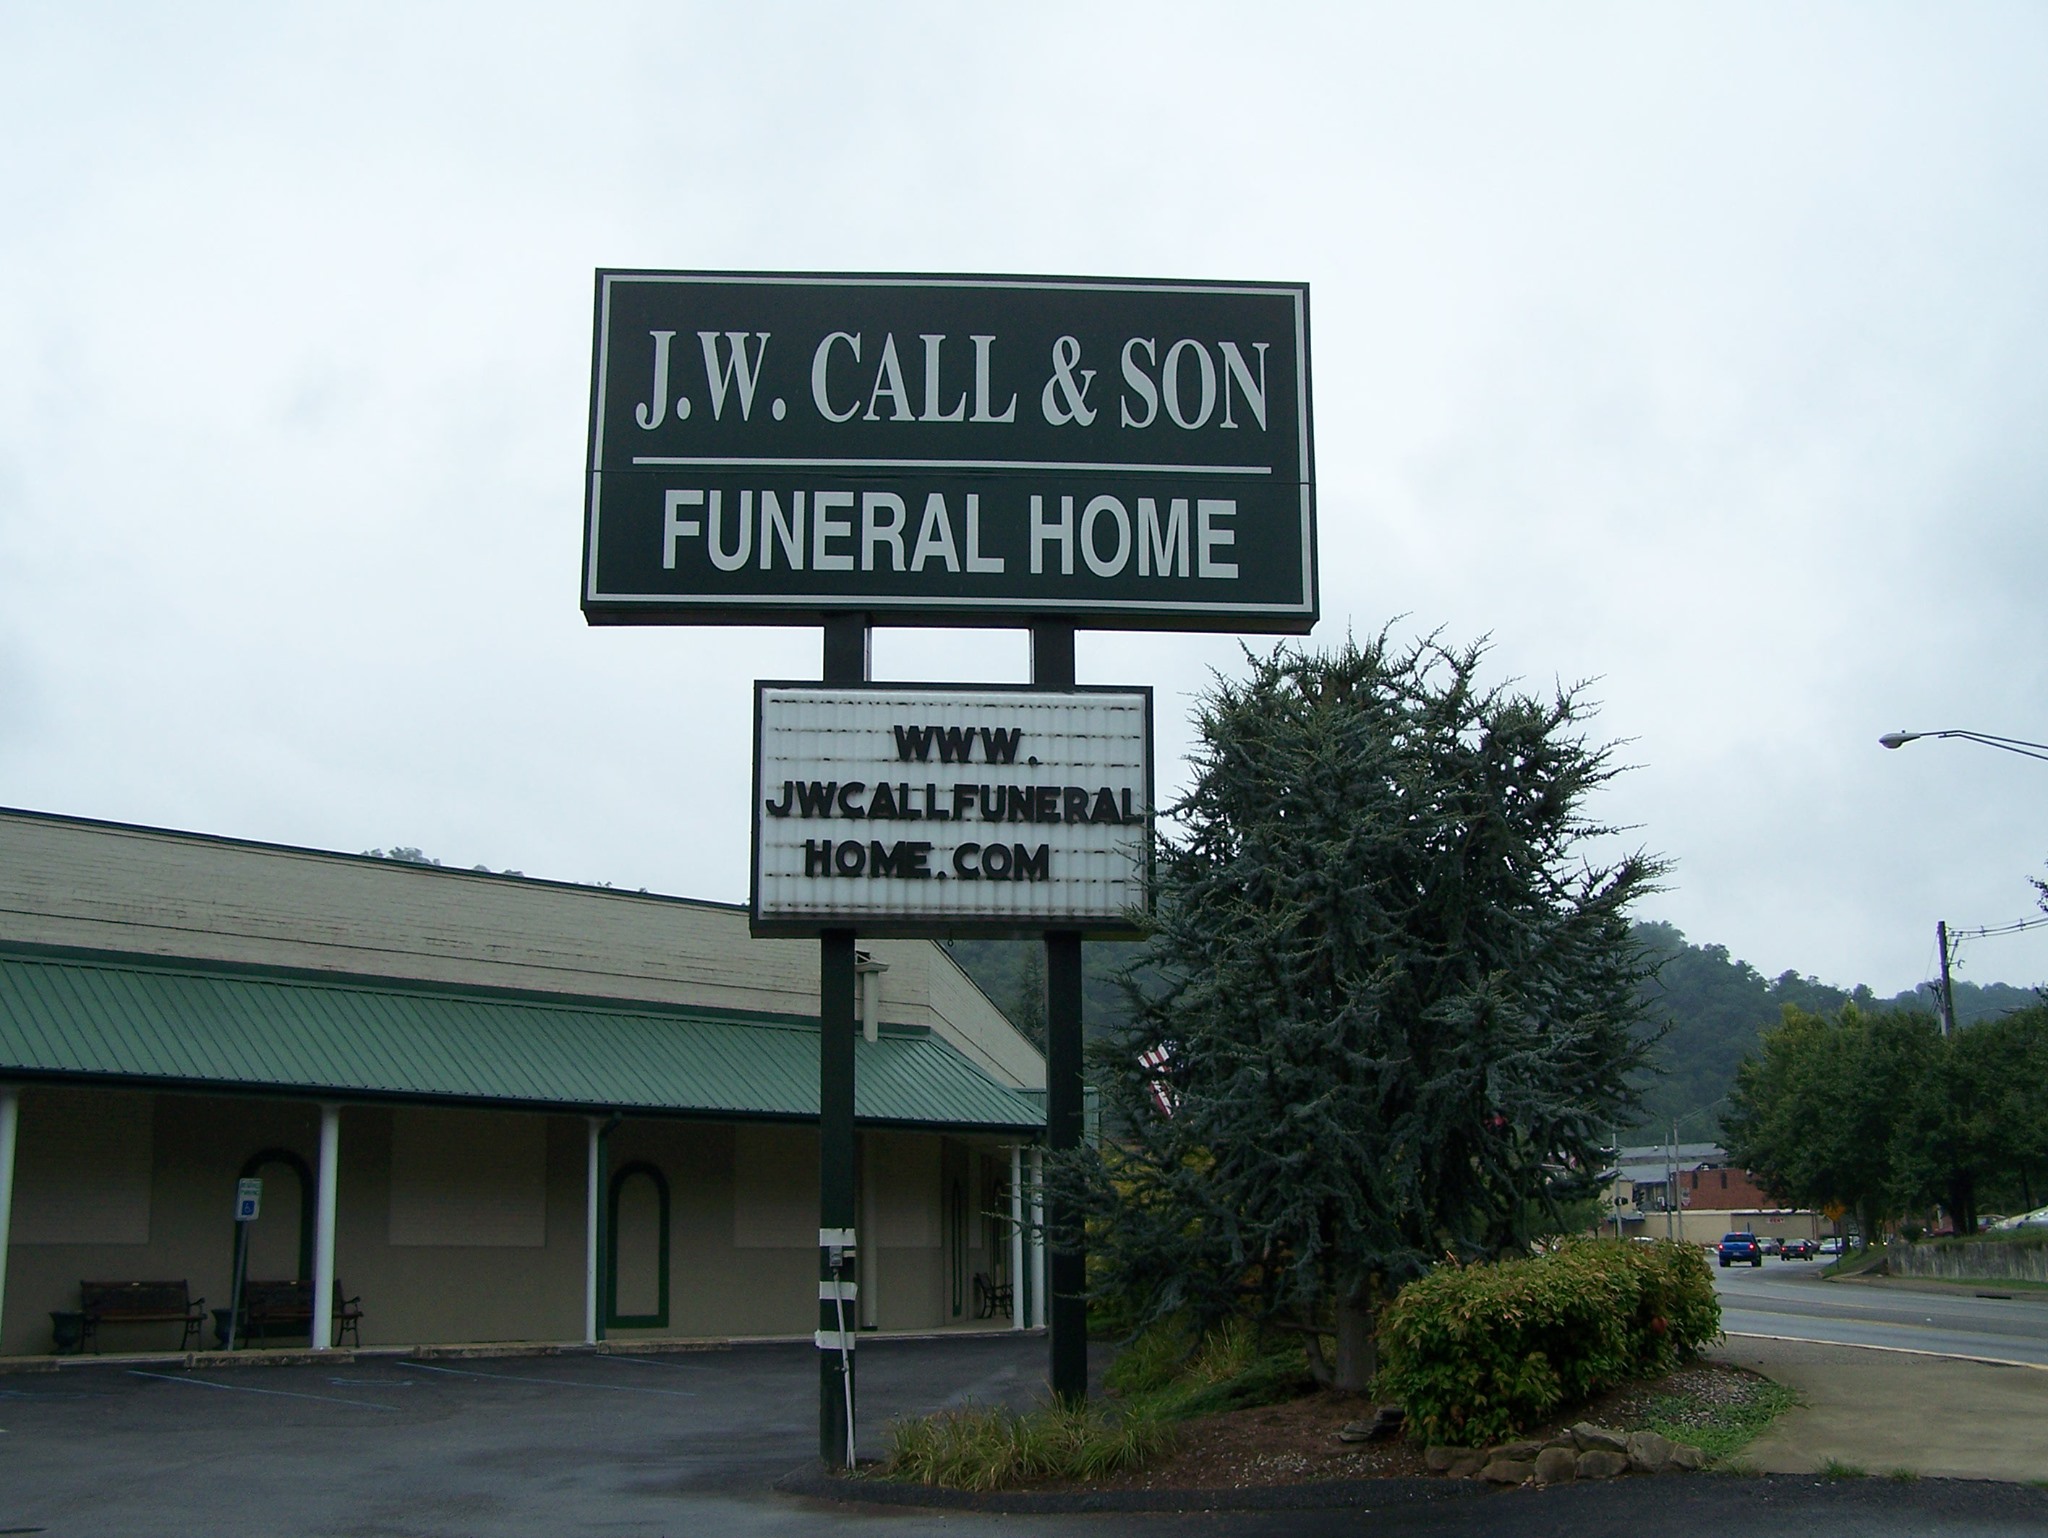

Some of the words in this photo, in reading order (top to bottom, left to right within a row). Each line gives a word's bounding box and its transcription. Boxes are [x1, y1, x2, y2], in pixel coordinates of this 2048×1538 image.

[635, 330, 787, 430] J.W.
[811, 331, 1018, 424] CALL
[1041, 335, 1099, 428] &
[1120, 337, 1271, 432] SON
[663, 489, 1005, 573] FUNERAL
[1030, 494, 1239, 579] HOME
[893, 724, 1041, 766] WWW.
[765, 780, 1145, 825] JWCALLFUNERAL
[804, 839, 1050, 882] HOME.COM
